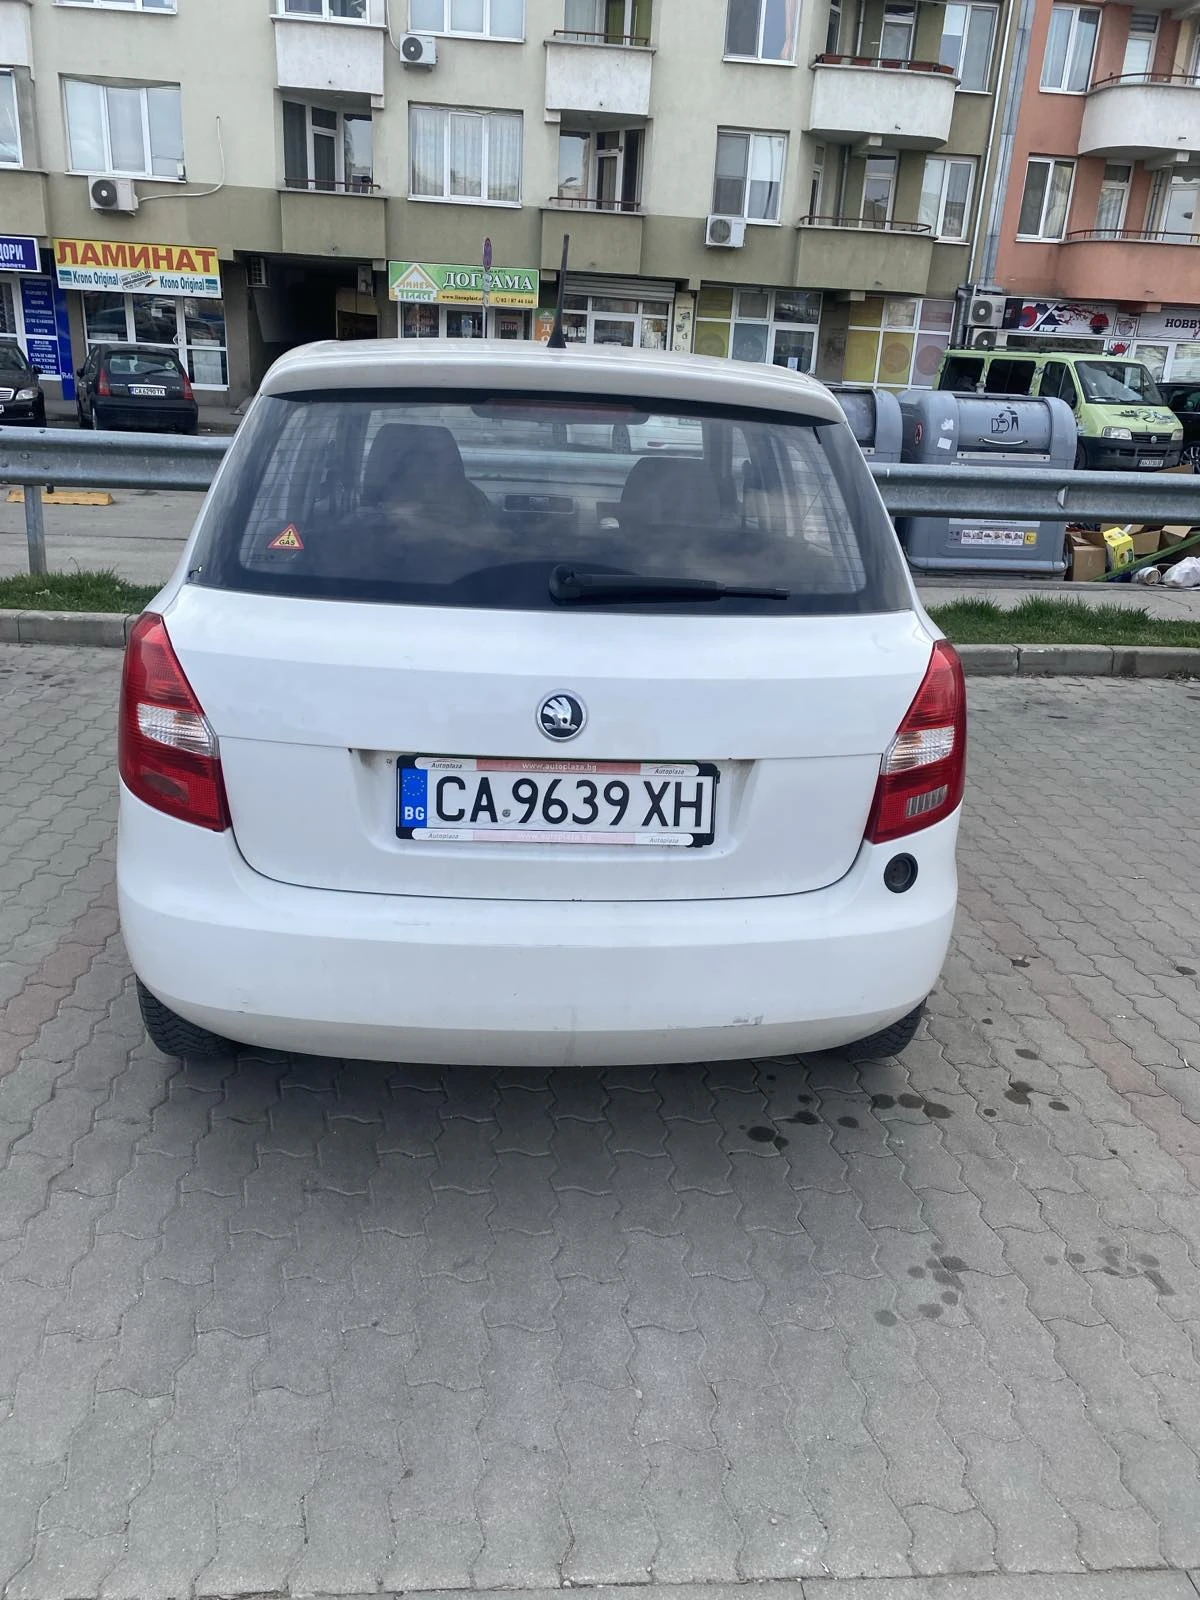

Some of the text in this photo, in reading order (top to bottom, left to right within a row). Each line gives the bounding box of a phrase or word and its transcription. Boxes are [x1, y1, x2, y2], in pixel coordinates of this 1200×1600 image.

[57, 241, 216, 272] ЛАМИНАТ
[72, 271, 92, 283] Krono
[93, 273, 119, 288] Original
[159, 276, 180, 290] Krono
[180, 278, 205, 293] Original
[431, 760, 463, 770] Autoplaza
[522, 762, 598, 772] www.autoplaza.bg
[654, 767, 685, 776] Autoplaza
[436, 775, 703, 828] CA 9639 XH
[404, 806, 425, 821] BG
[427, 831, 459, 840] Autoplaza
[649, 836, 680, 845] Autoplaza
